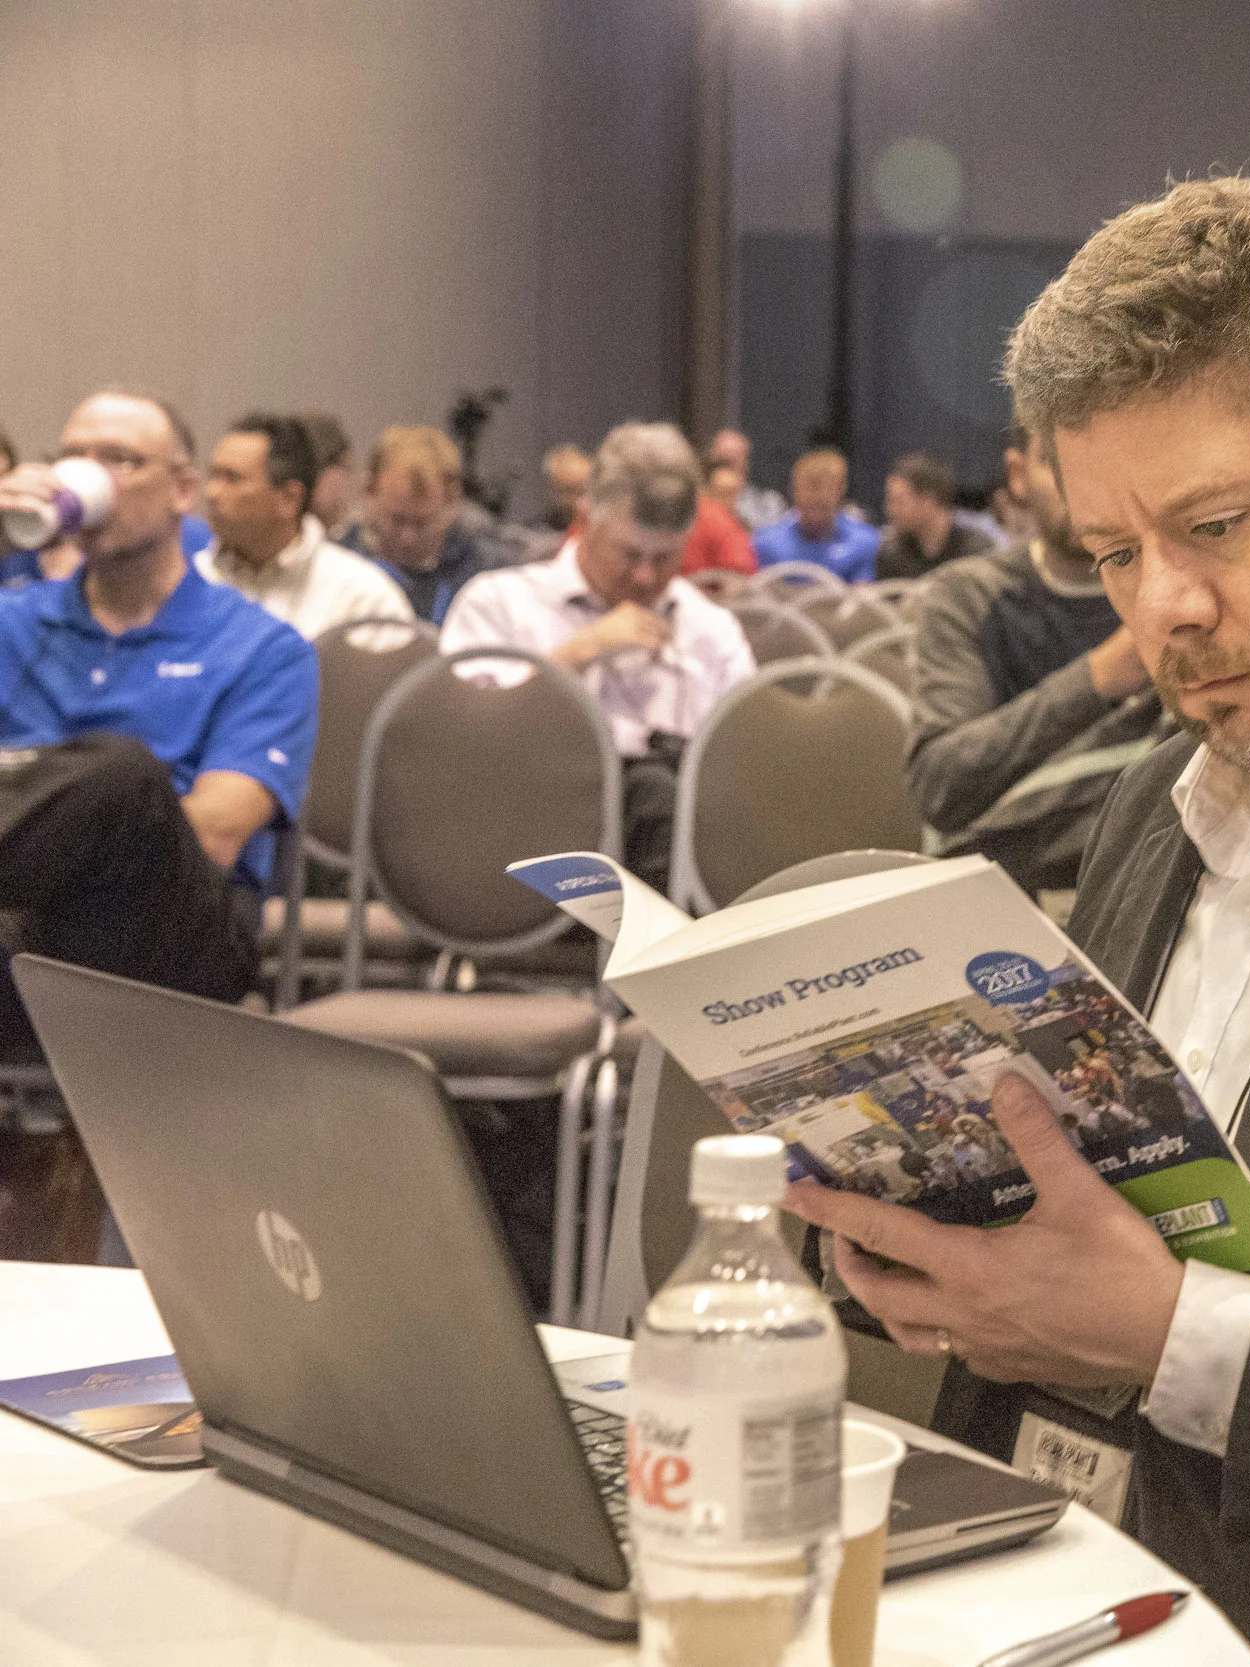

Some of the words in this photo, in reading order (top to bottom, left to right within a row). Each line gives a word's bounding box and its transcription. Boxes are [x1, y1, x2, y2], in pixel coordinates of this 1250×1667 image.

[702, 990, 787, 1025] Show
[784, 947, 925, 1001] Program
[977, 962, 1032, 995] 2017
[1133, 1135, 1190, 1165] Apply.
[1154, 1203, 1211, 1236] EPLANT
[626, 1422, 692, 1512] ke
